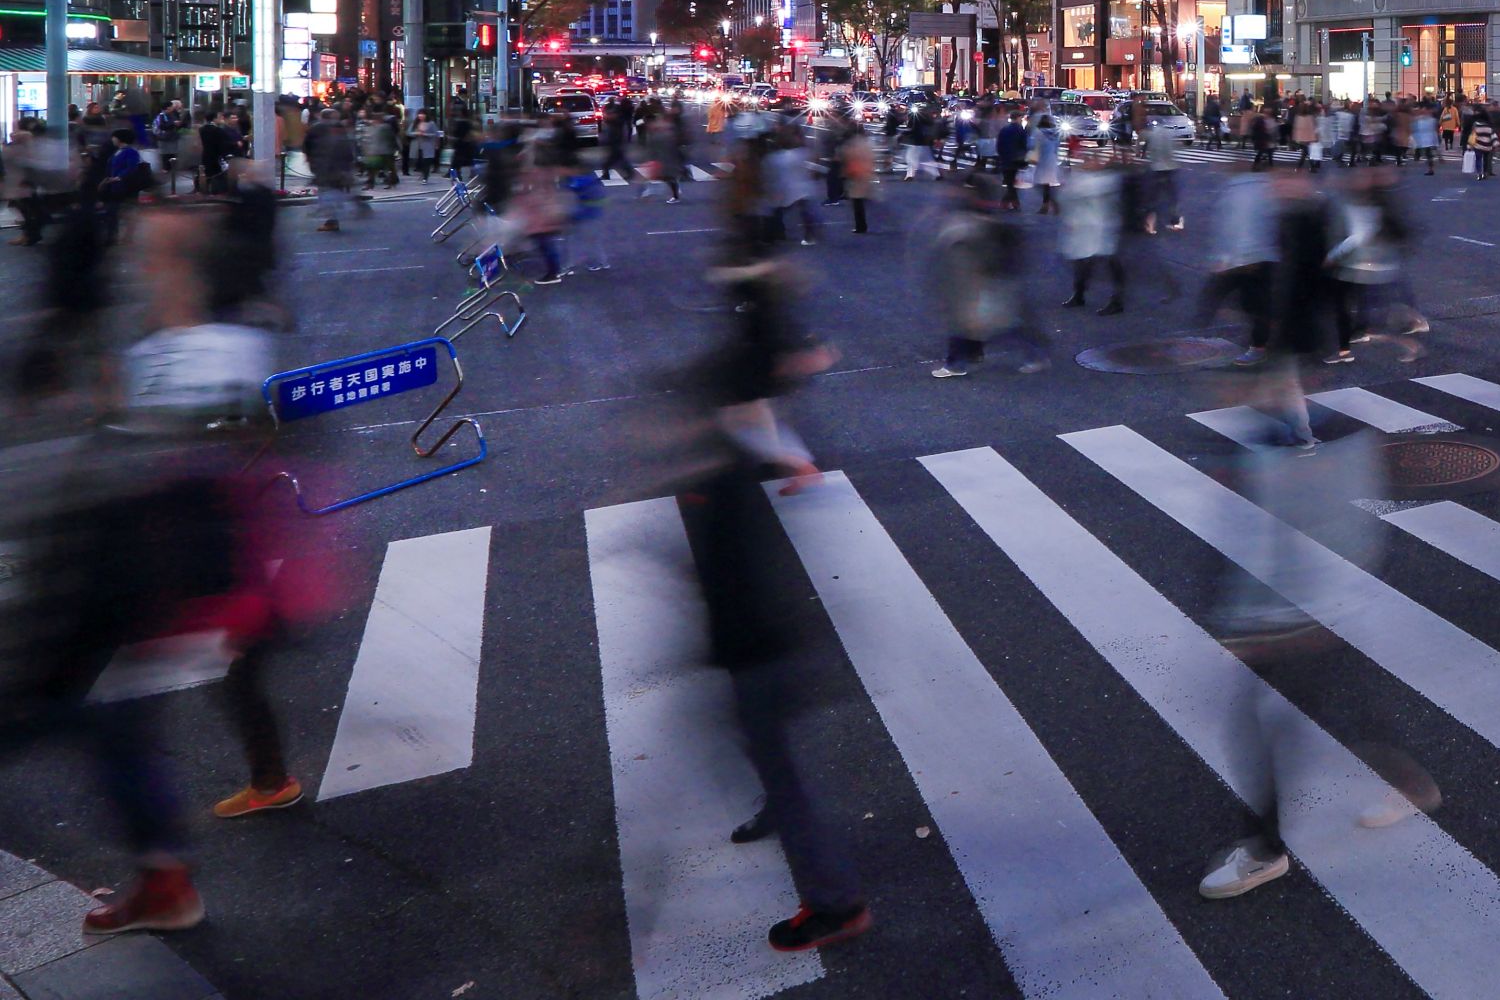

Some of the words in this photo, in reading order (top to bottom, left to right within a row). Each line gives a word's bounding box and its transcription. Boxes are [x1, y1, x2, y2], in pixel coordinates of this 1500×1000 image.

[291, 357, 428, 402] 歩行者天国実施中
